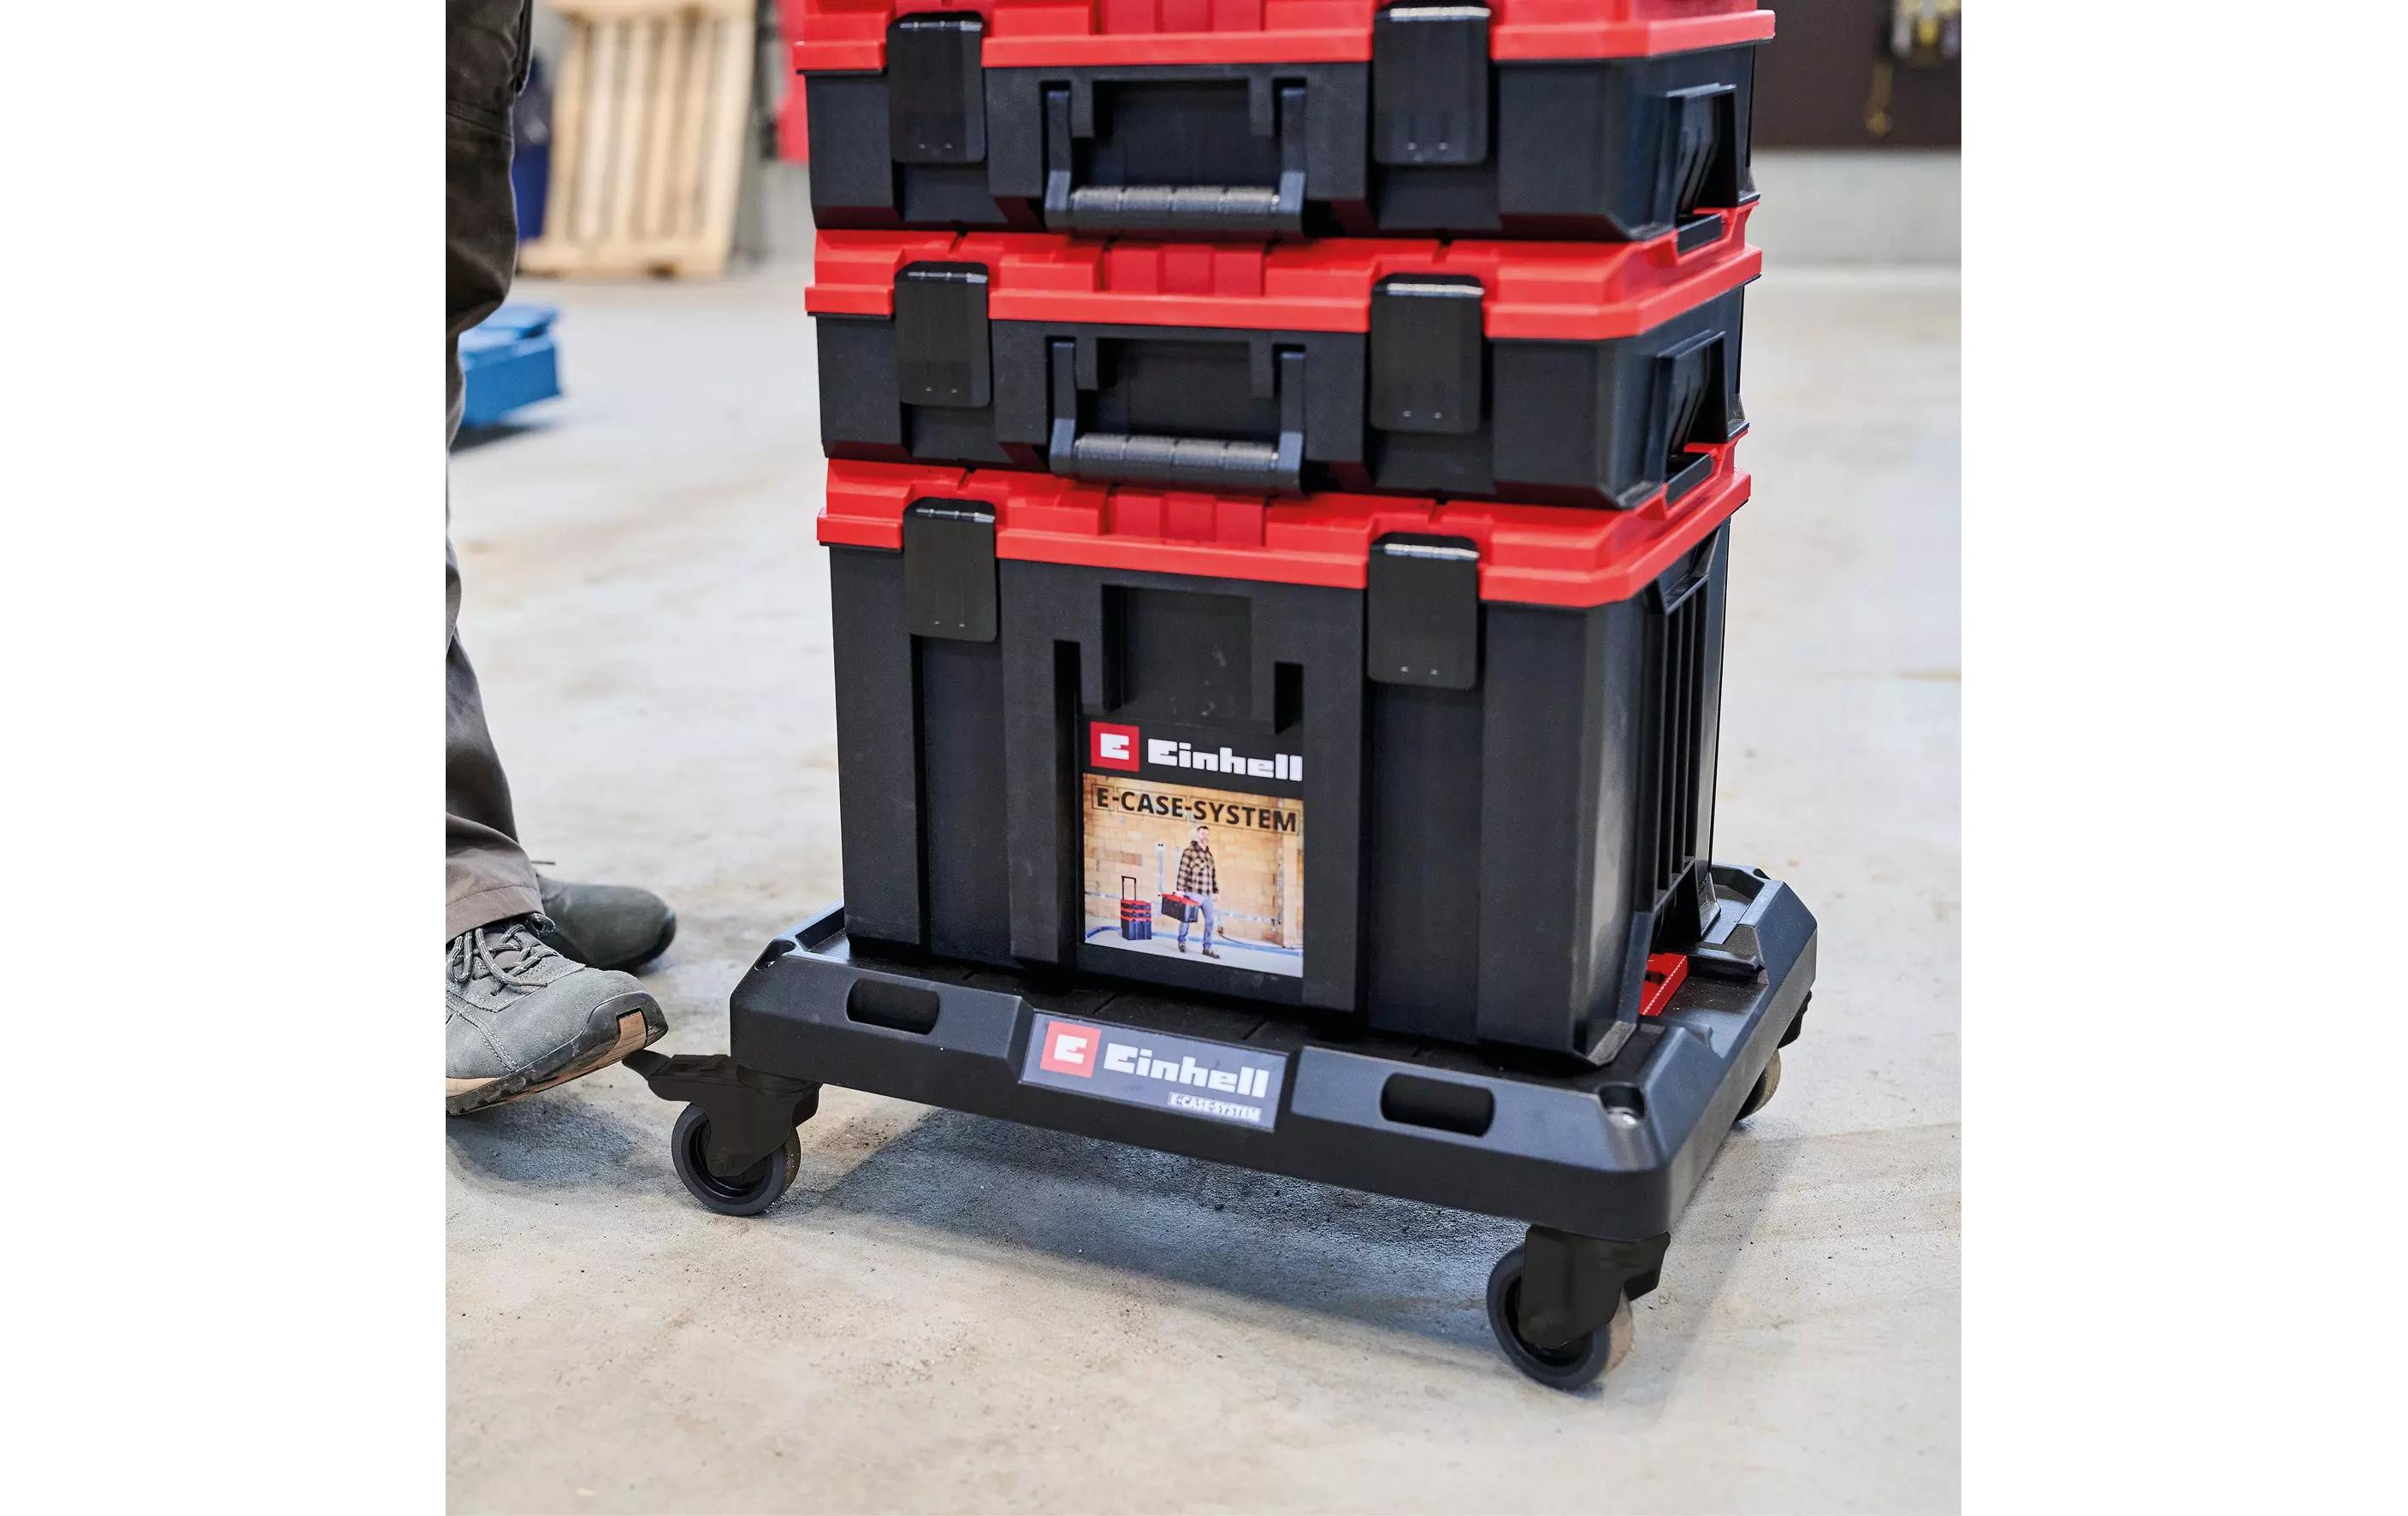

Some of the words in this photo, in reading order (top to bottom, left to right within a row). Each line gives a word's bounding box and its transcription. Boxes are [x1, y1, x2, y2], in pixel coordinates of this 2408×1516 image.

[1148, 738, 1303, 781] Einhell
[1097, 788, 1296, 832] E-CASE-SYSTEM
[1103, 1043, 1269, 1098] Einhell
